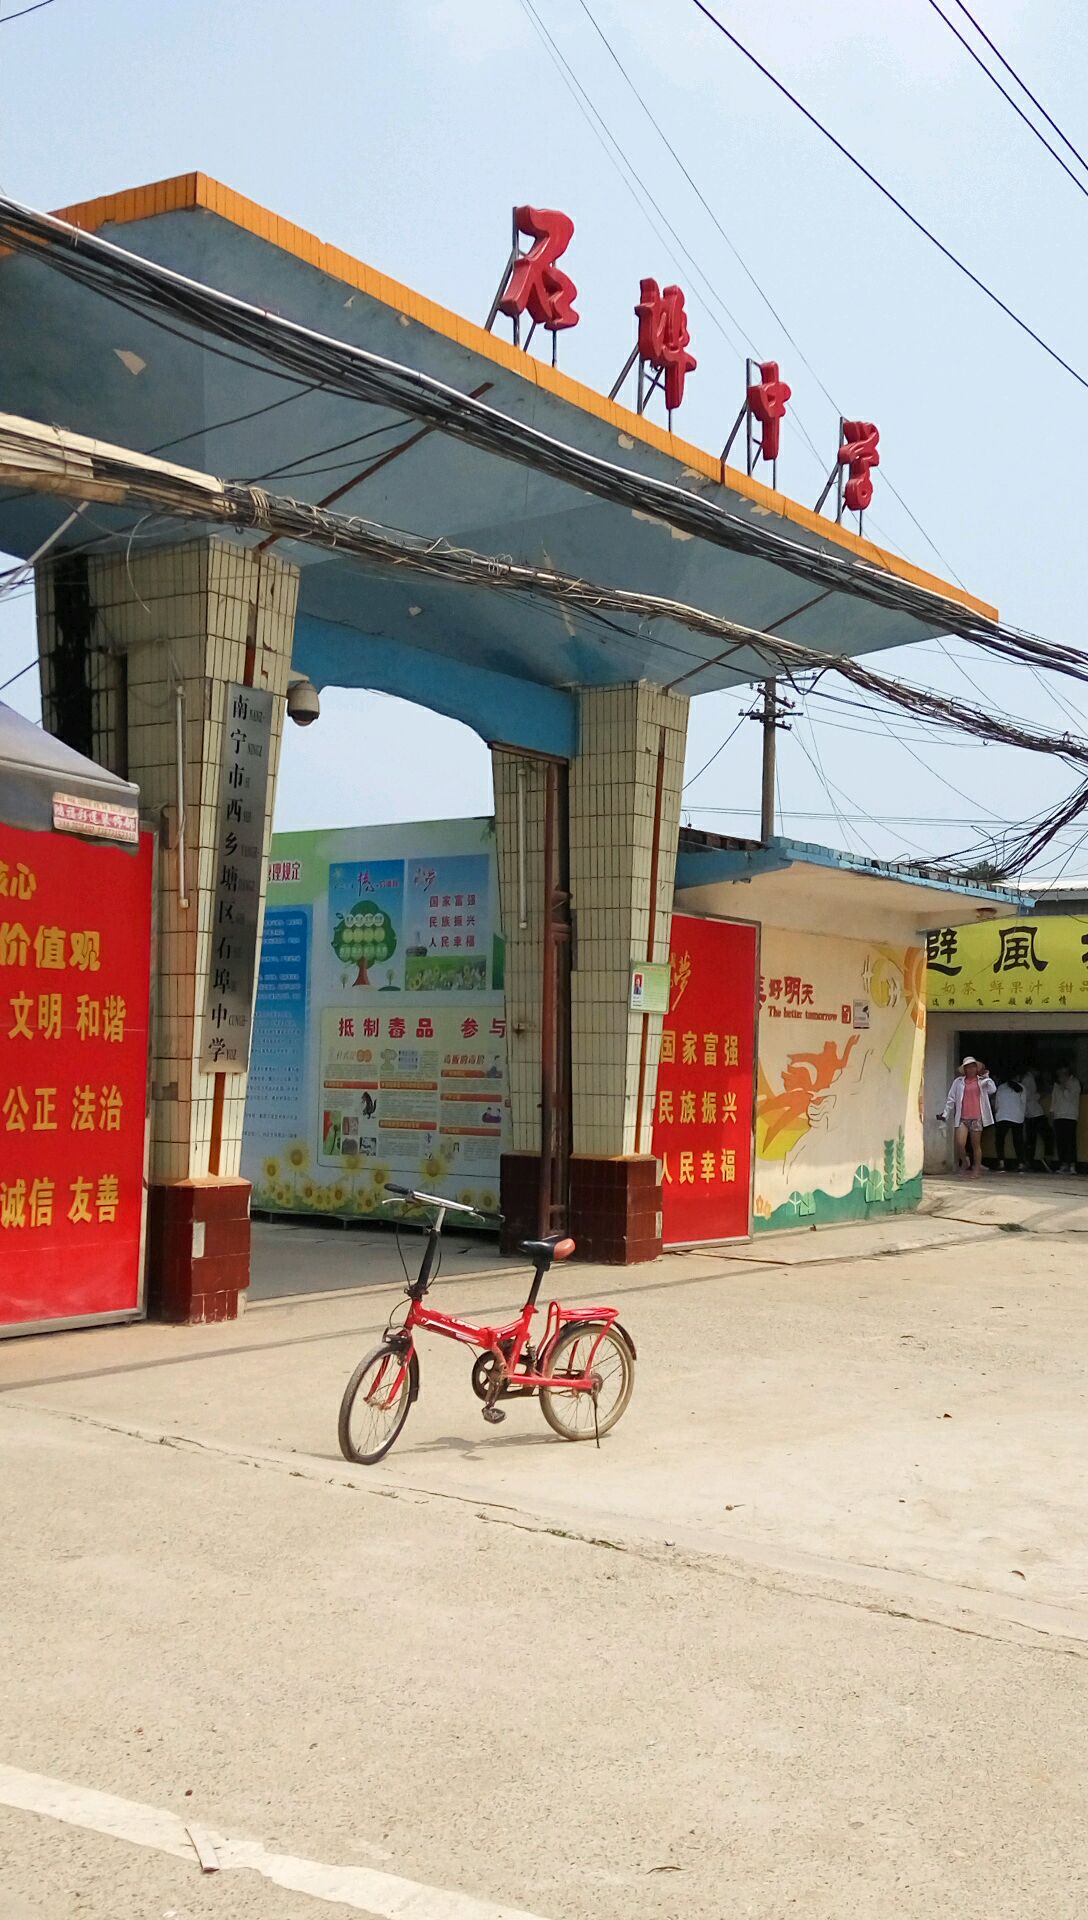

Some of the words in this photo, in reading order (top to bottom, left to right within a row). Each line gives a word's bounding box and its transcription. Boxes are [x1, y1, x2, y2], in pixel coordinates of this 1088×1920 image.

[429, 894, 477, 908] 国家富强
[429, 915, 476, 928] 民族振兴
[0, 922, 101, 971] 价值观
[428, 935, 475, 948] 人民幸福
[926, 926, 1088, 977] 避風
[942, 980, 976, 995] 奶茶
[989, 979, 1043, 995] 鲜果汁
[8, 991, 62, 1040] 文明
[76, 994, 126, 1042] 和谐
[338, 1017, 434, 1039] 抵制毒品
[460, 1017, 507, 1039] 参与
[768, 1005, 781, 1018] The
[783, 1007, 802, 1019] better
[805, 1010, 838, 1021] tomorrow
[661, 1030, 739, 1067] 国家富强
[2, 1086, 58, 1132] 公正
[71, 1085, 124, 1131] 法治
[658, 1090, 738, 1125] 民族振兴
[661, 1148, 737, 1185] 人民幸福
[0, 1177, 55, 1228] 诚信
[67, 1174, 119, 1225] 友善
